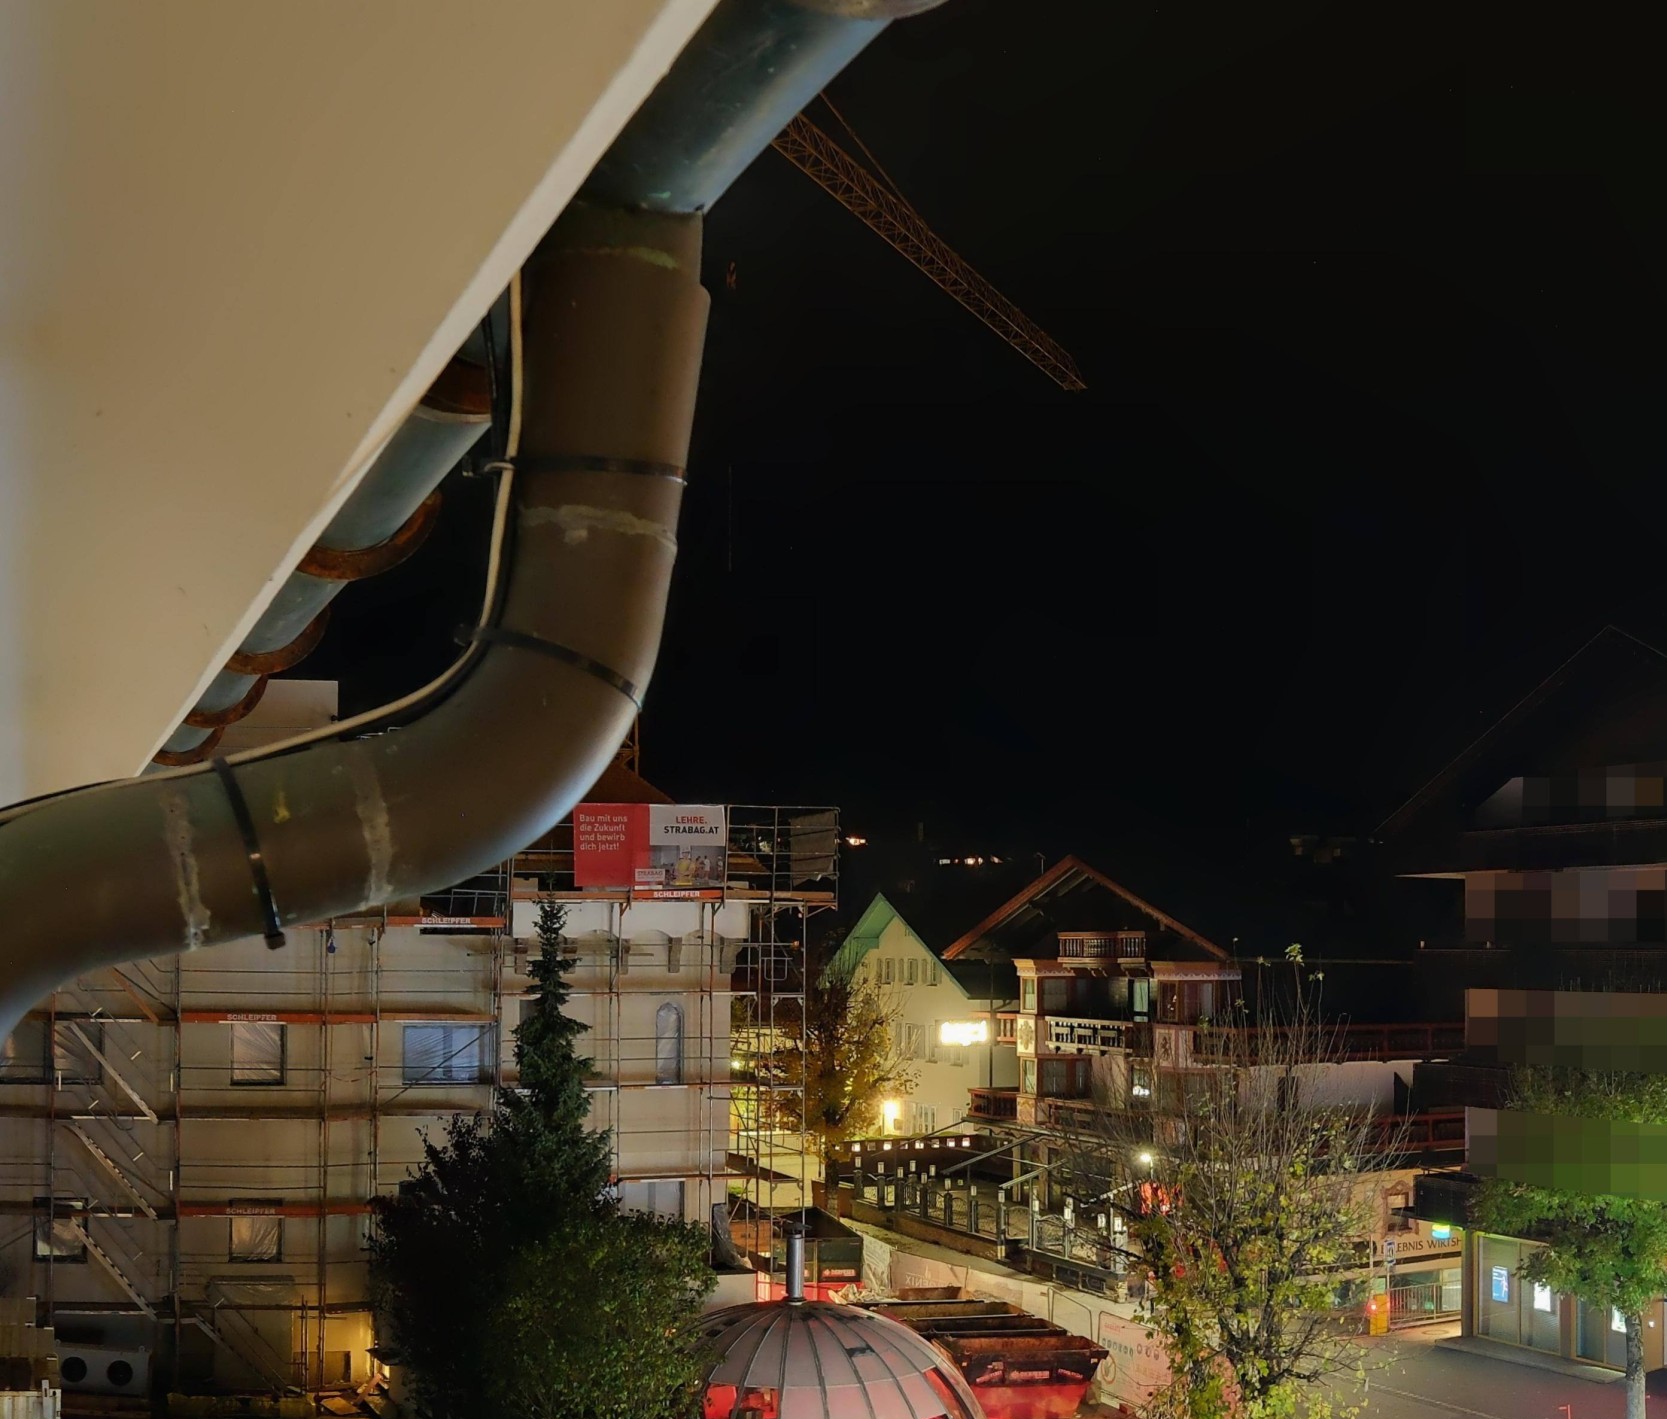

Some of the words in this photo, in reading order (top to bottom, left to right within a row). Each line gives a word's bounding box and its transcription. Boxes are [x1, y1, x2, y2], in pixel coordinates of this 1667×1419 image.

[579, 814, 596, 823] Bau
[597, 814, 611, 823] mit
[612, 815, 628, 823] uns
[675, 815, 708, 824] LEHRE.
[579, 823, 592, 832] die
[593, 823, 626, 832] Zukunft
[663, 826, 720, 835] STRABAG.AT
[579, 833, 596, 841] und
[597, 833, 626, 841] bewirb
[580, 842, 596, 851] dich
[598, 842, 620, 853] jetzt!
[653, 890, 700, 898] SCHLEIPFER
[226, 1013, 277, 1021] SCHLEIPFER
[225, 1207, 276, 1215] SCHLEIPFER
